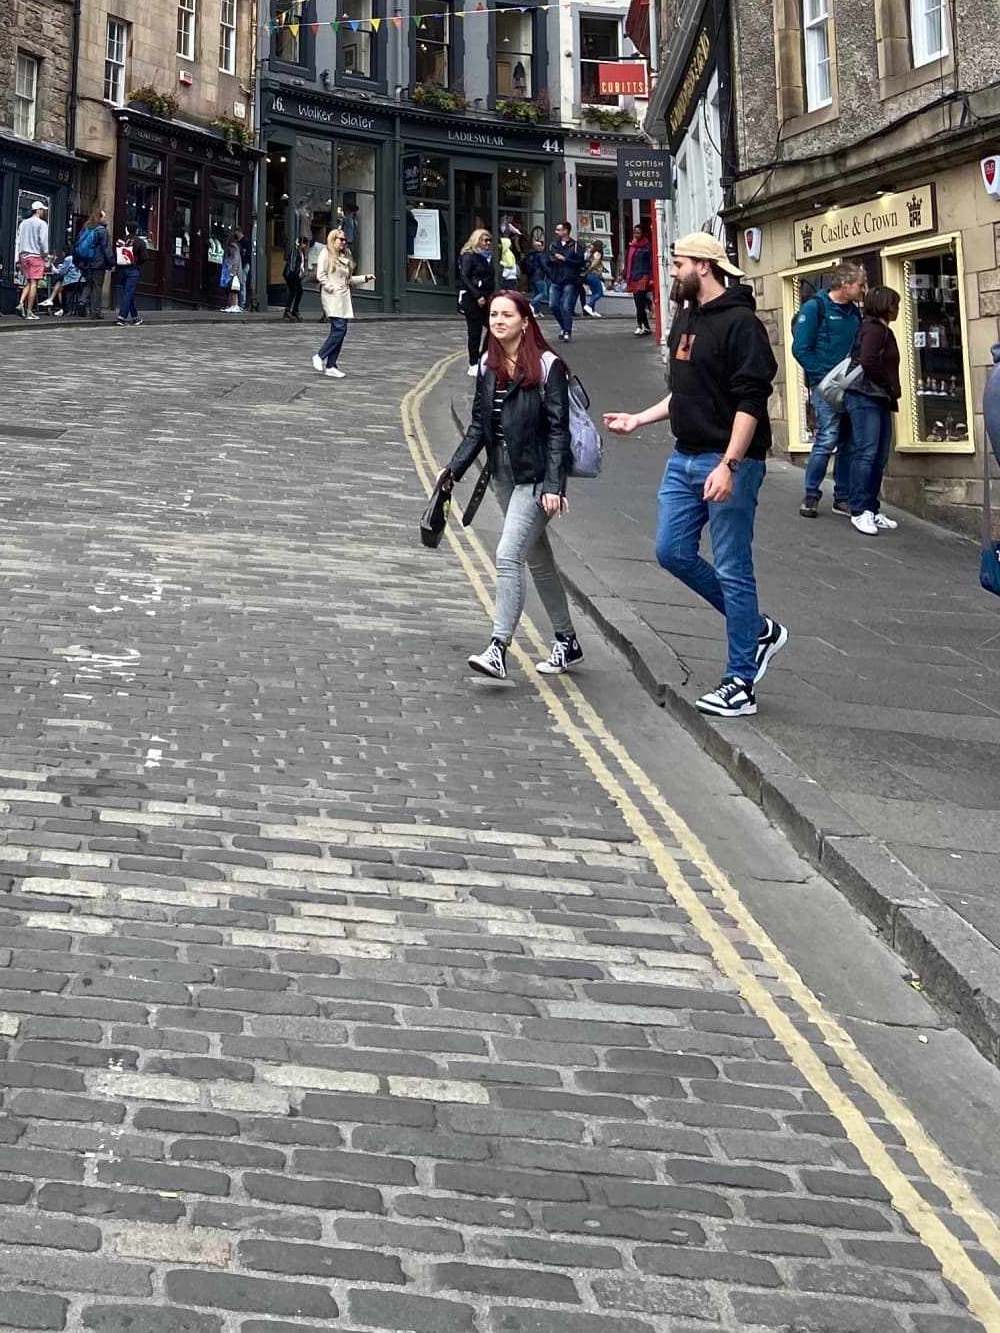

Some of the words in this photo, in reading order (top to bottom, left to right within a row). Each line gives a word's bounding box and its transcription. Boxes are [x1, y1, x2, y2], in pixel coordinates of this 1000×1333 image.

[602, 81, 644, 93] CUBITTS
[298, 104, 334, 122] Walker
[340, 112, 375, 129] Slater
[447, 130, 504, 146] LADIESWEAR
[542, 138, 564, 153] 44.
[624, 160, 664, 168] SCOTTISH
[57, 169, 70, 183] 89
[628, 170, 661, 178] SWEETS
[634, 180, 663, 188] TREATS
[820, 218, 849, 243] Castle
[852, 216, 861, 236] &
[863, 211, 898, 233] Crown
